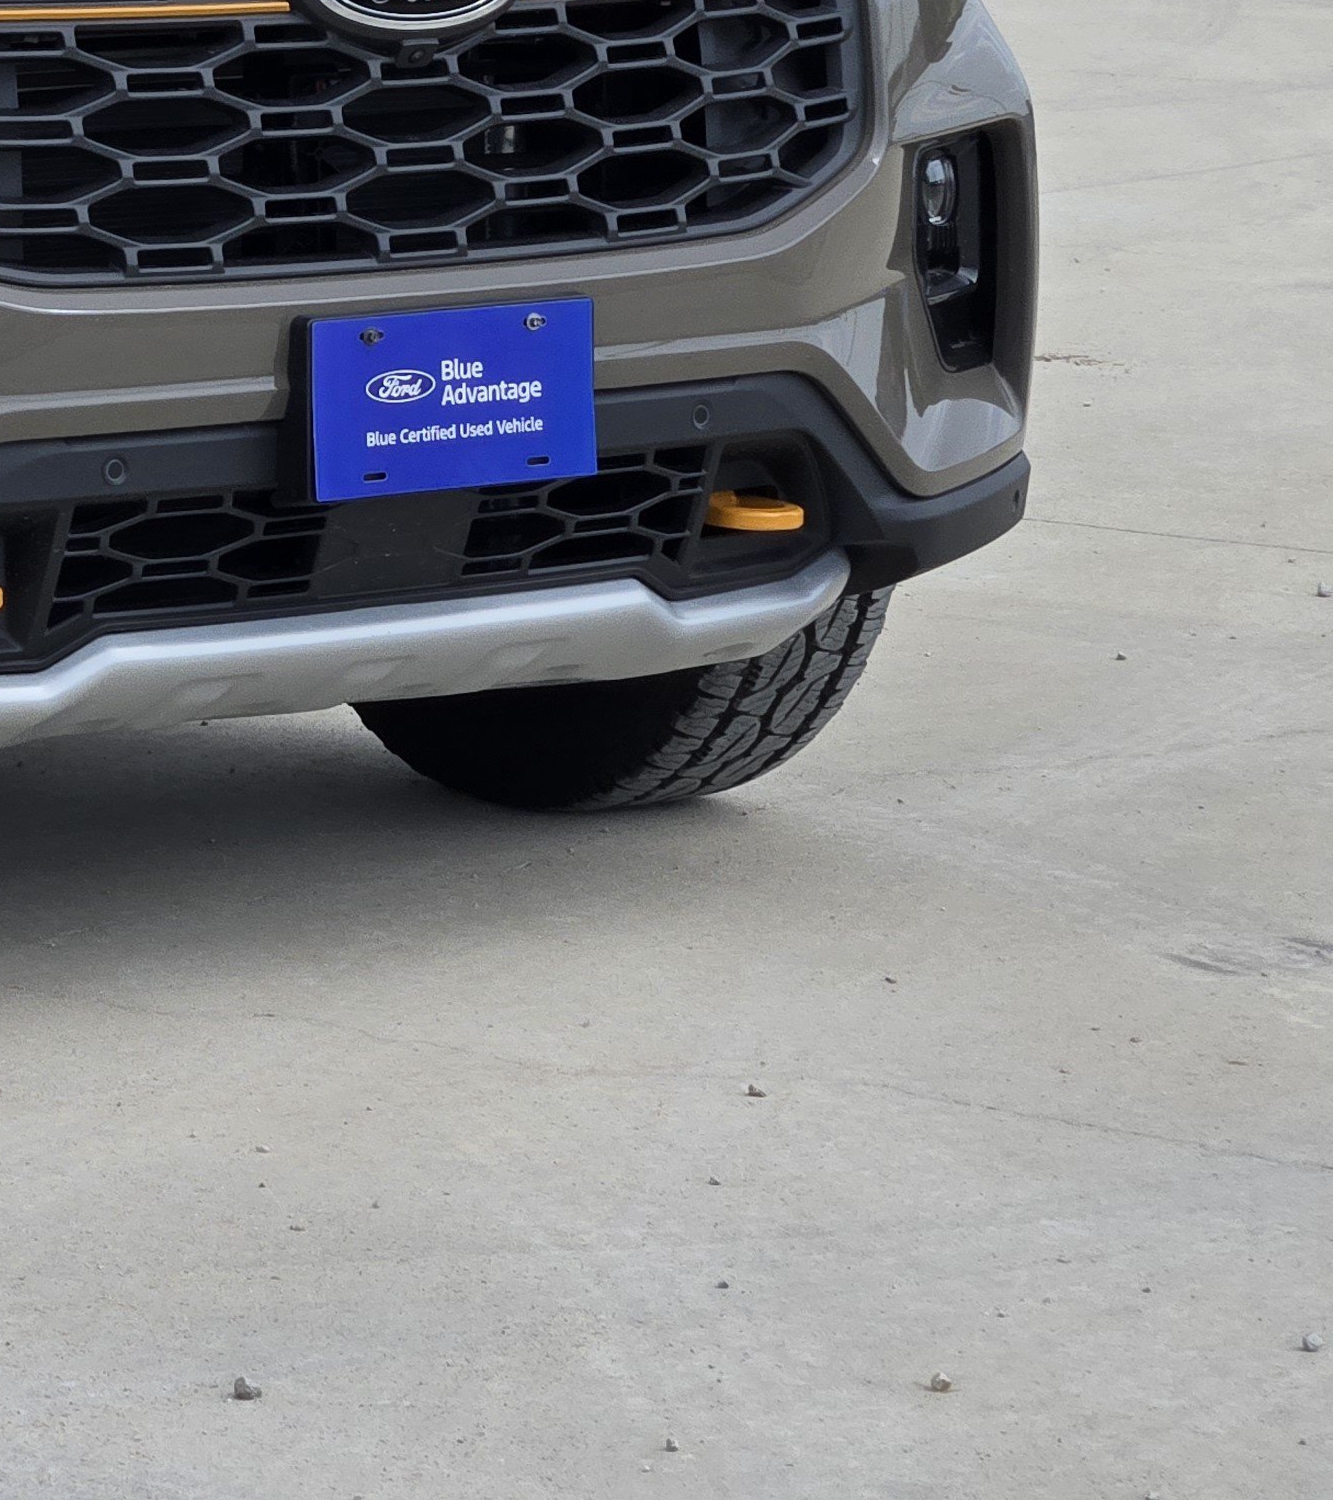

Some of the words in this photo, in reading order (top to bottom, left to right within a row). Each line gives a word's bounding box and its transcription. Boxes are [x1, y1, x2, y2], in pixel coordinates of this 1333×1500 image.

[441, 358, 483, 381] Blue
[378, 374, 423, 398] Ford
[441, 379, 543, 406] Advantage
[366, 431, 396, 448] Blue
[399, 424, 456, 444] Certified
[460, 420, 493, 439] Used
[496, 416, 544, 435] Vehicle
